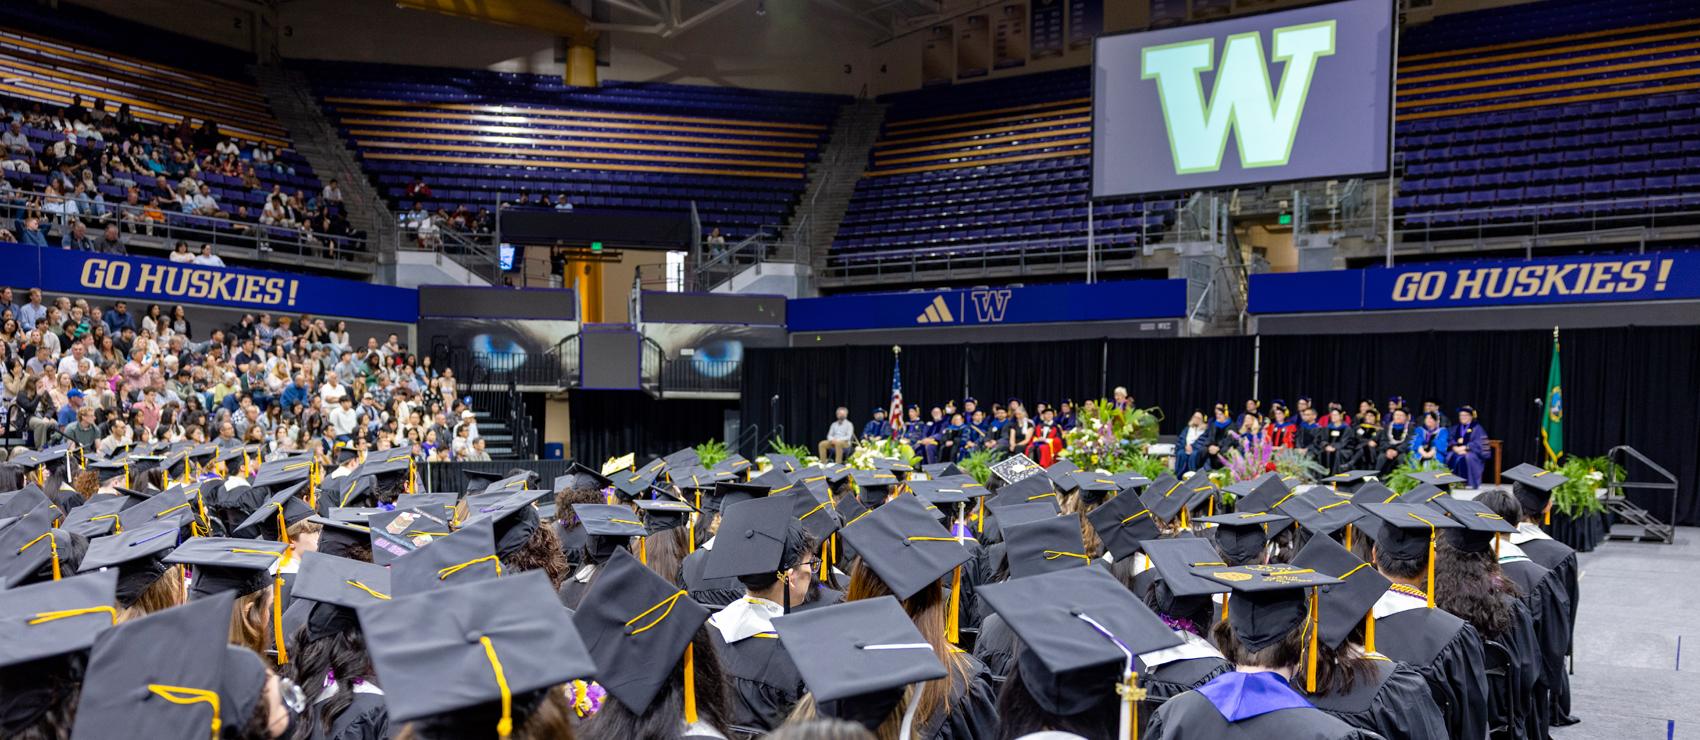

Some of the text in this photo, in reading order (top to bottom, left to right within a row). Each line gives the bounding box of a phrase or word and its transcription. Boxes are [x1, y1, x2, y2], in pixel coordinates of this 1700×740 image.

[1141, 19, 1337, 175] W
[80, 258, 131, 290] GO
[1391, 271, 1447, 302] GO
[971, 289, 1012, 322] W
